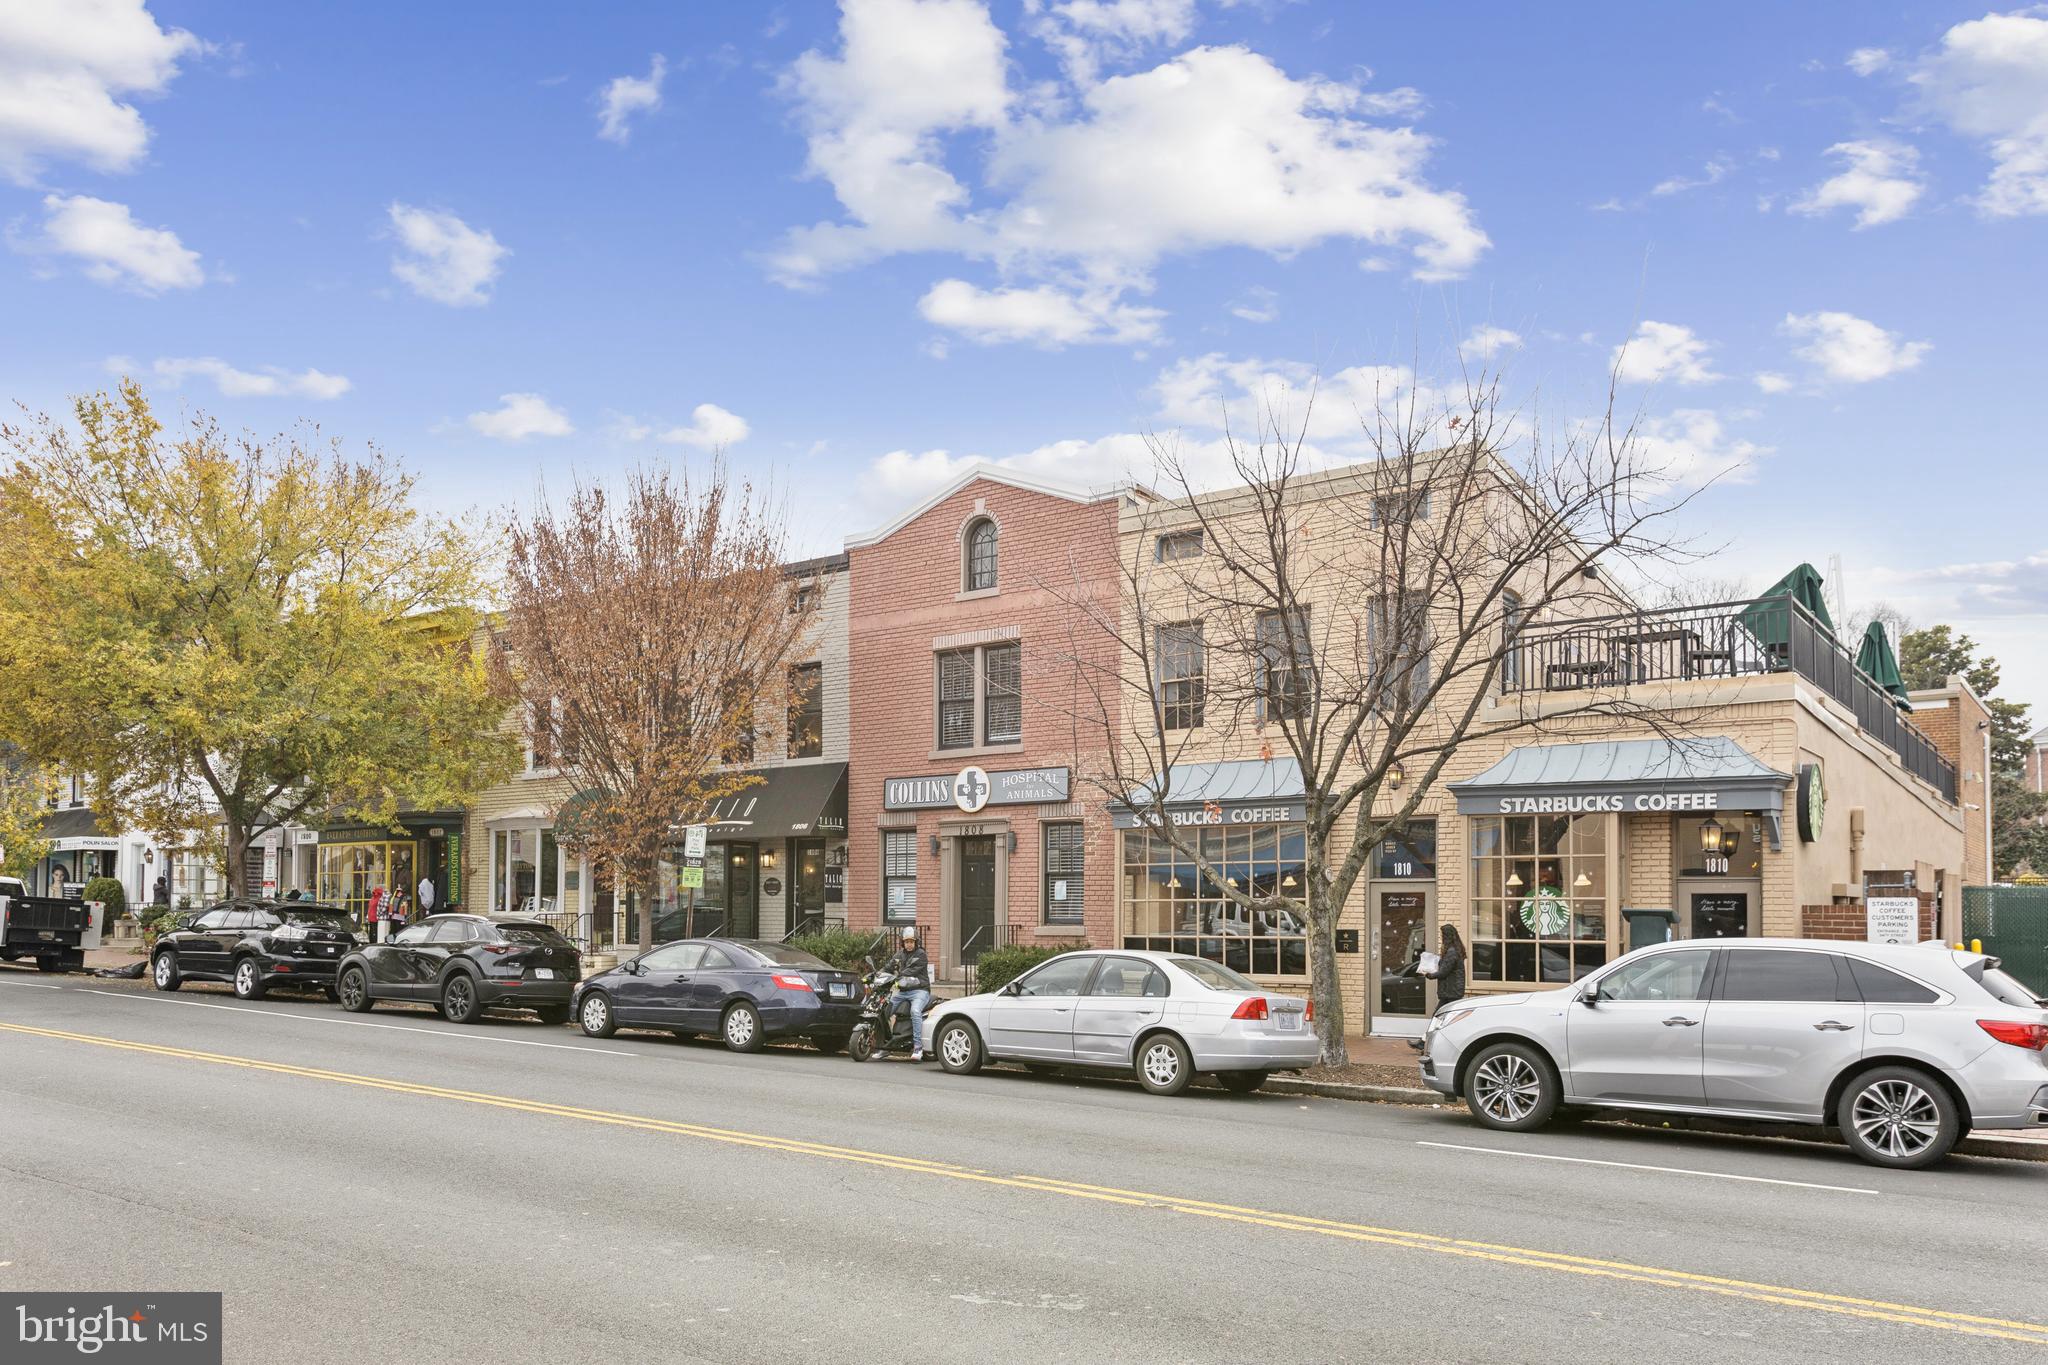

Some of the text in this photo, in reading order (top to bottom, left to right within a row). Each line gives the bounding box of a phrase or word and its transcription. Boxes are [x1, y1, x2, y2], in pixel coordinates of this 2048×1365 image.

[1002, 772, 1060, 788] HOSPITAL
[890, 780, 949, 804] COLLINS
[1006, 788, 1054, 799] ANIMALS
[1500, 792, 1718, 813] STARBUCKS COFFEE
[1231, 807, 1290, 824] COFFEE
[959, 825, 985, 836] 1808
[1393, 862, 1412, 876] 1810
[1705, 858, 1729, 873] 1810
[450, 869, 459, 902] CLOTHING
